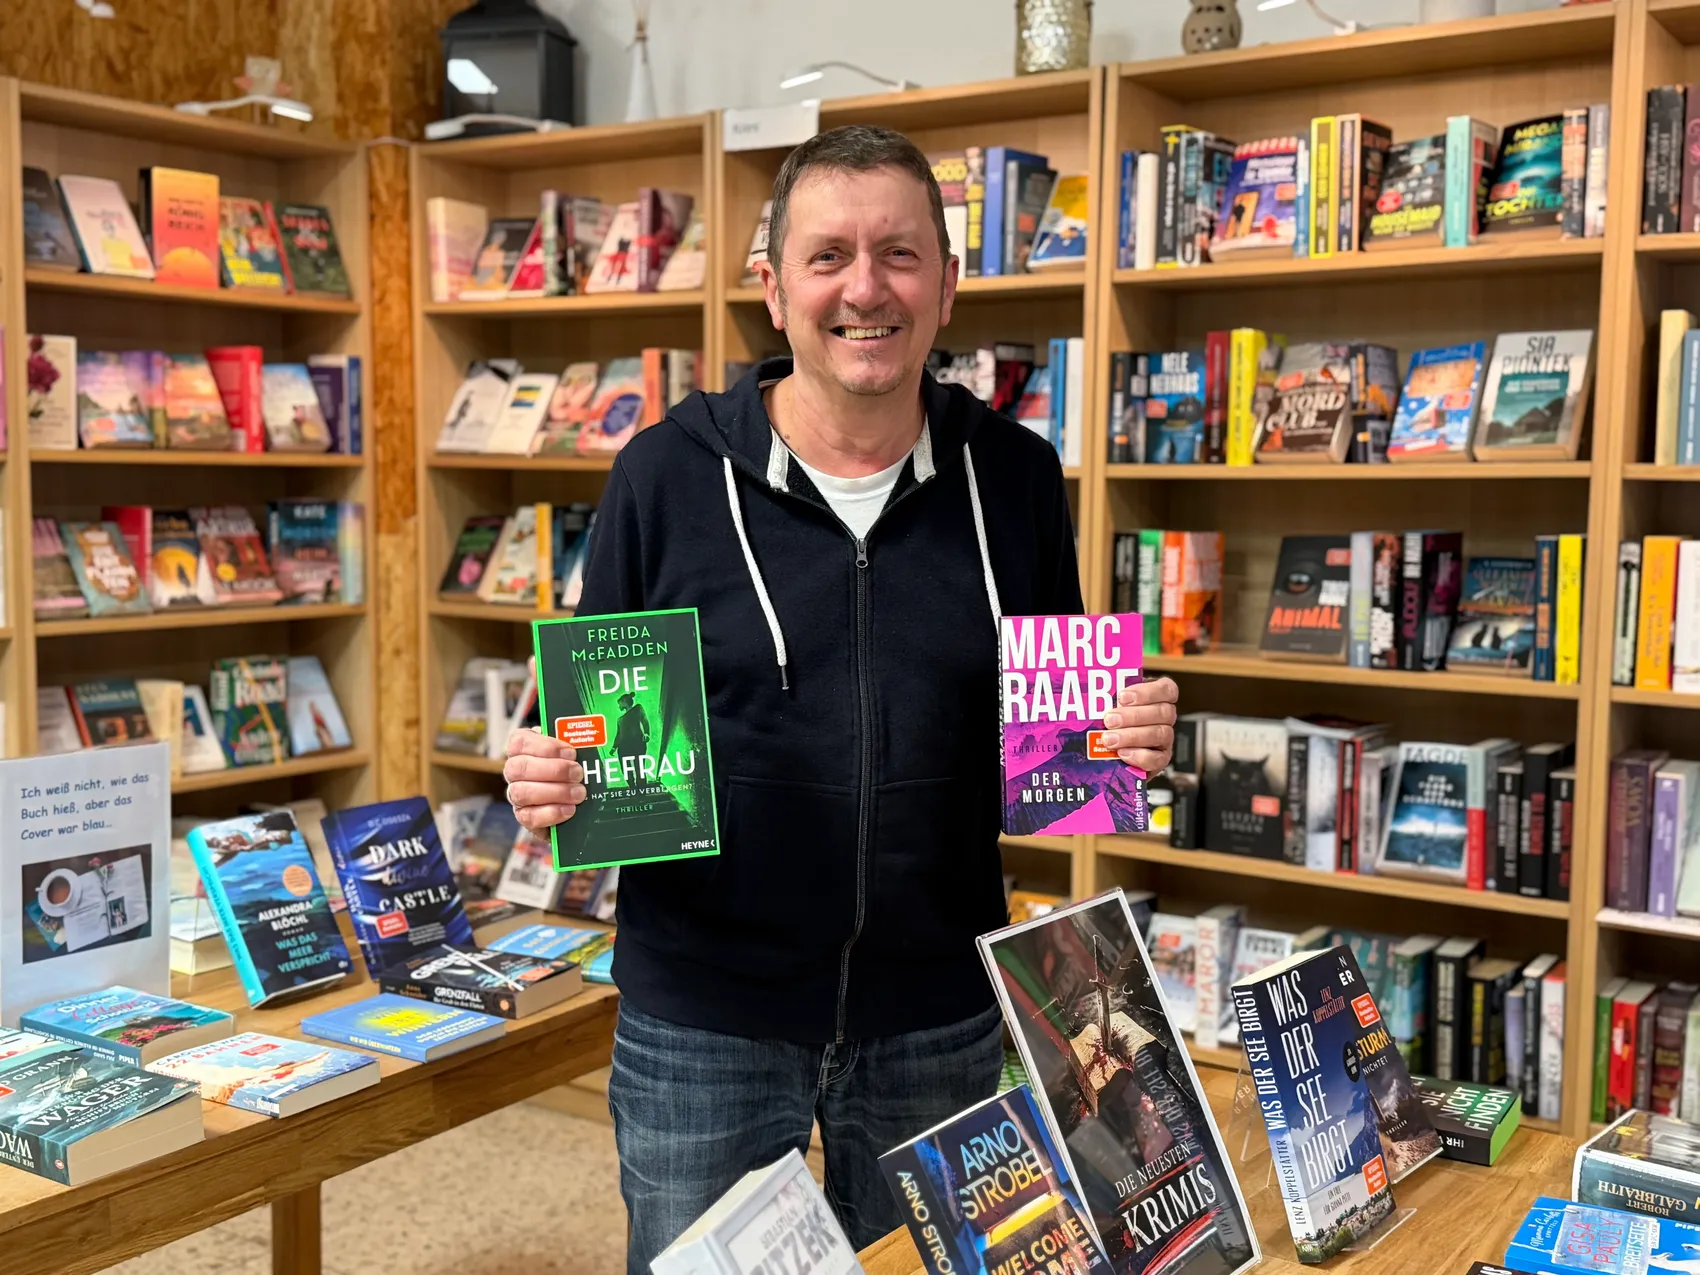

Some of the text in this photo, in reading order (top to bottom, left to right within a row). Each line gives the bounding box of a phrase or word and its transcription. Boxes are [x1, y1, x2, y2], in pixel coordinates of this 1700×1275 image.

[1269, 605, 1342, 630] ANIMAL
[587, 625, 651, 643] FREIDA
[1002, 615, 1121, 670] MARC
[571, 641, 669, 663] McFADDEN
[598, 666, 649, 695] DIE
[566, 720, 595, 730] SPIEGEL
[569, 735, 595, 744] Autorin
[1013, 744, 1059, 755] THRILLER
[582, 750, 697, 786] HEFRAU
[1031, 771, 1061, 787] DER
[21, 773, 150, 799] Ich weiß nicht, wie das
[591, 782, 693, 801] HAT SIE ZU VERBERGEN?
[1022, 787, 1086, 804] MORGEN
[21, 796, 132, 820] Buch hieß, aber das
[616, 804, 654, 814] THRILLER
[1137, 791, 1145, 830] ullstein
[21, 828, 53, 840] Cover
[58, 824, 78, 835] war
[681, 840, 710, 851] HEYNE
[368, 836, 429, 865] DARK
[258, 901, 313, 922] ALEXANDRA
[379, 885, 452, 912] CASTLE
[271, 914, 309, 931] BLÖCHL
[275, 932, 318, 950] WAS DAS
[288, 945, 314, 959] MEER
[277, 951, 331, 973] VERSPRICHT
[1200, 925, 1216, 1015] MAROR
[57, 995, 120, 1013] Dinner
[434, 986, 482, 1002] GRENZFALL
[1266, 970, 1308, 1026] WAS
[1233, 990, 1262, 1032] BIRGT
[119, 1055, 135, 1065] PIPER
[1245, 1036, 1270, 1062] SEE
[1281, 1022, 1320, 1079] DER
[1363, 1055, 1389, 1076] NICHTET
[1253, 1067, 1278, 1095] DER
[25, 1075, 152, 1127] WAGER
[1296, 1073, 1332, 1128] SEE
[1437, 1086, 1481, 1121] NICHT
[1464, 1088, 1513, 1131] FINDEN
[1261, 1100, 1287, 1131] WAS
[959, 1120, 1022, 1180] ARNO
[1301, 1119, 1354, 1190] BIRGT
[1446, 1136, 1464, 1148] IHR
[1115, 1140, 1192, 1199] DIE NEUESTEN
[1276, 1139, 1306, 1225] LENZ KOPPELSTÄTTER
[959, 1148, 1053, 1220] STROBEL
[1598, 1180, 1687, 1212] GALBRAITH
[1121, 1163, 1217, 1254] KRIMIS
[1626, 1200, 1670, 1217] ROBERT
[760, 1205, 799, 1250] SEBASTIAN
[897, 1172, 957, 1275] ARNO STRO
[991, 1216, 1085, 1275] WELCOME
[1567, 1223, 1595, 1255] GISA
[1593, 1217, 1623, 1265] PAULY
[1623, 1221, 1648, 1267] BREITSEITE
